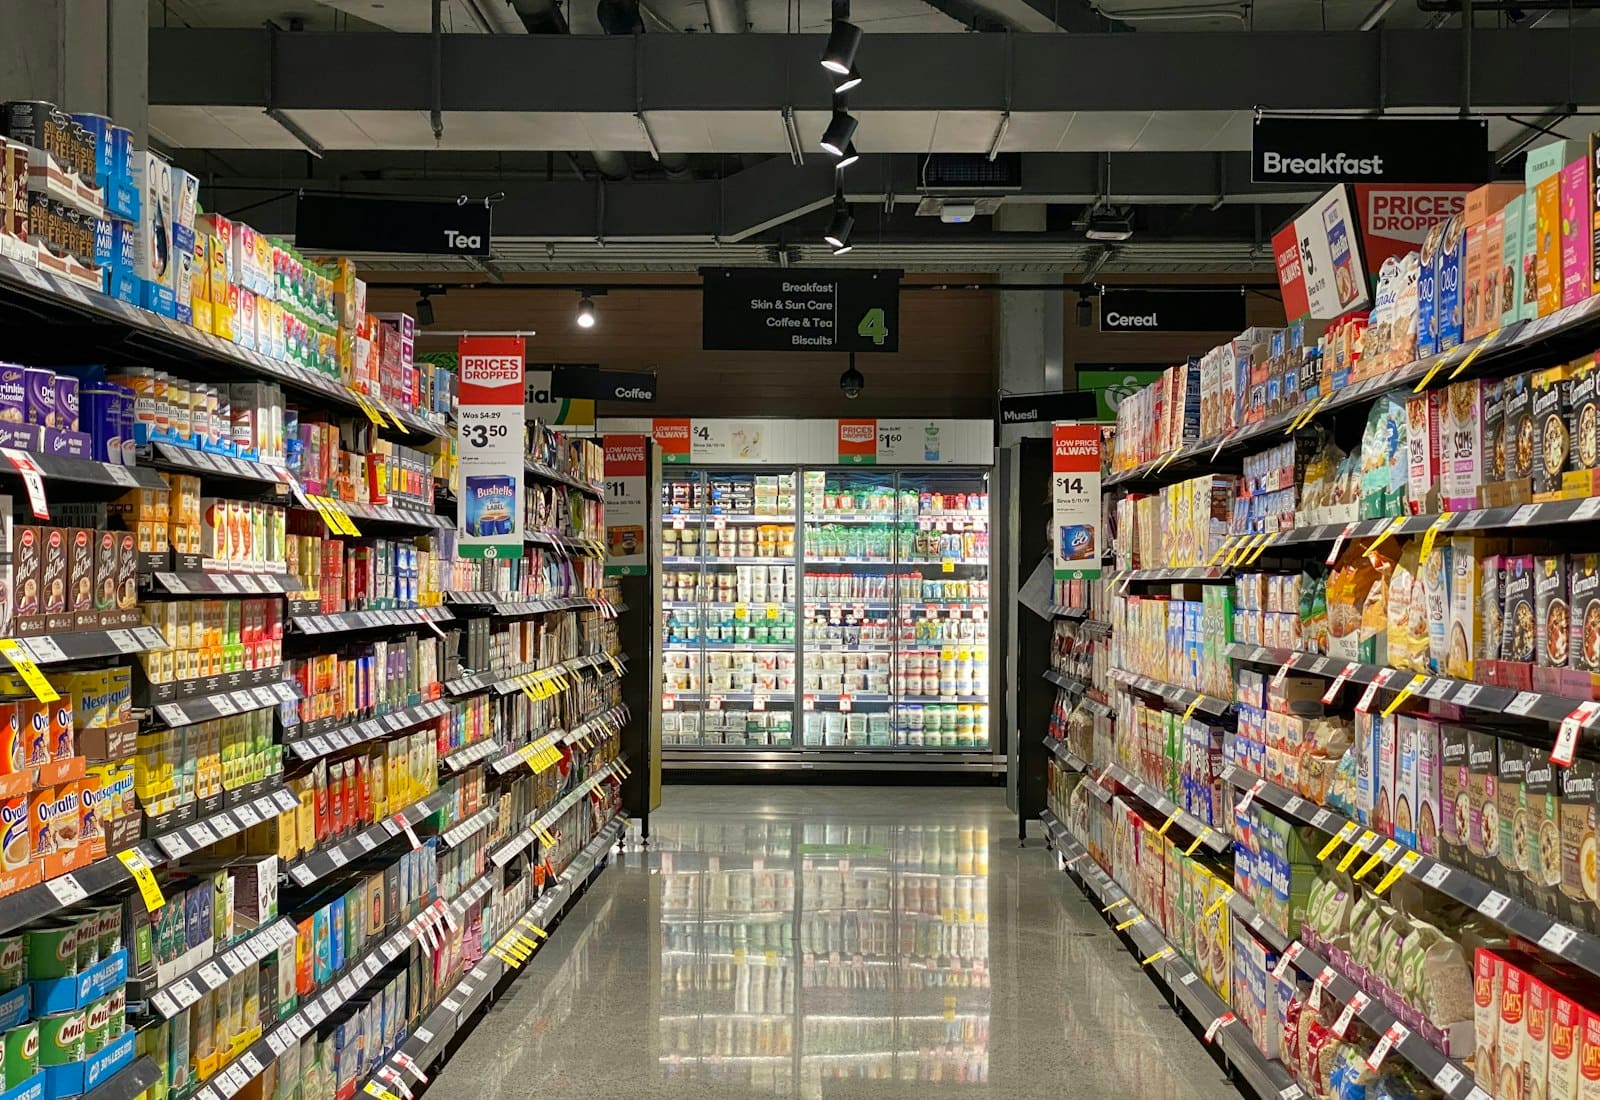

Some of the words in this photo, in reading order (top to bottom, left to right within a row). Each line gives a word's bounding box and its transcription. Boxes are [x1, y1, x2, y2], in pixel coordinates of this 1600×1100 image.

[1263, 152, 1383, 175] Breakfast
[1373, 196, 1465, 215] PRICES
[444, 230, 481, 248] Tea
[782, 282, 833, 292] Breakfast
[751, 300, 773, 310] Skin
[775, 300, 784, 310] &
[785, 300, 805, 310] Sun
[807, 301, 833, 311] Care
[766, 317, 800, 328] Coffee
[802, 318, 811, 328] &
[812, 318, 833, 328] Tea
[857, 307, 889, 345] 4
[1107, 312, 1159, 327] Cereal
[792, 335, 833, 346] Biscuits
[465, 359, 518, 370] PRICES
[465, 371, 518, 380] DROPPED
[615, 387, 652, 400] Coffee
[1004, 410, 1038, 421] Muesli
[693, 427, 710, 440] $4
[1056, 439, 1074, 447] LOW
[1056, 447, 1098, 455] ALWAYS
[477, 485, 512, 498] Bushells
[606, 482, 625, 496] $11
[1056, 478, 1083, 494] $14
[486, 503, 504, 511] LABEL
[1503, 990, 1521, 1012] OATS
[1552, 1022, 1572, 1045] OATS
